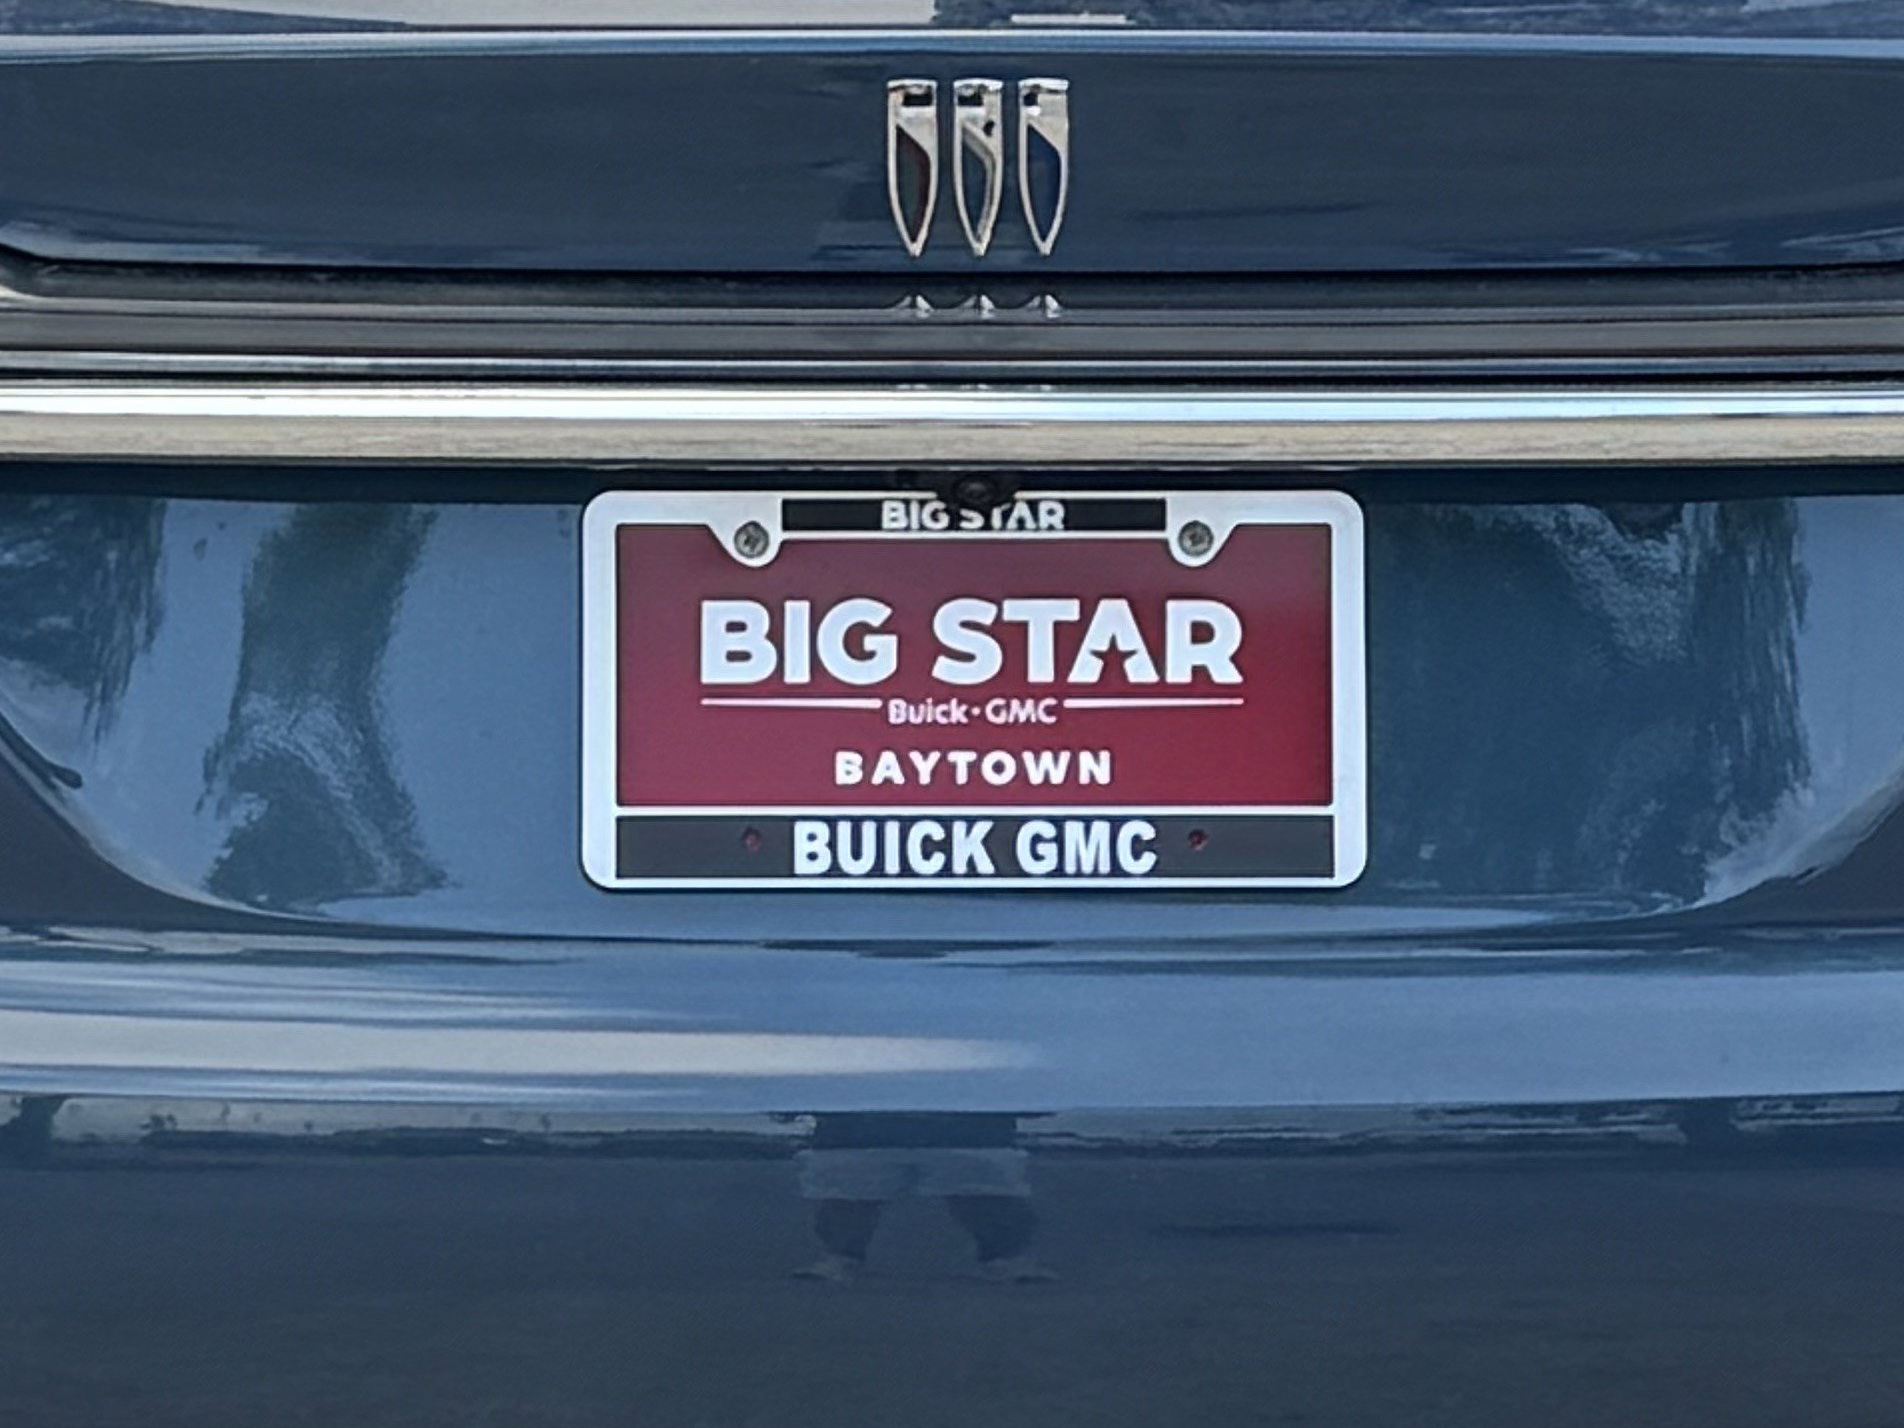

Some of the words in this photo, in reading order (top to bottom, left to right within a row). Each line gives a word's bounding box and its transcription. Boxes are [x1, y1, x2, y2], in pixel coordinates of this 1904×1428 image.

[881, 499, 951, 531] BIG
[700, 598, 898, 686] BIG
[931, 598, 1244, 686] STAR
[834, 751, 1113, 786] BAYTOWN
[793, 820, 995, 876] BUICK
[1017, 820, 1158, 876] GMC
